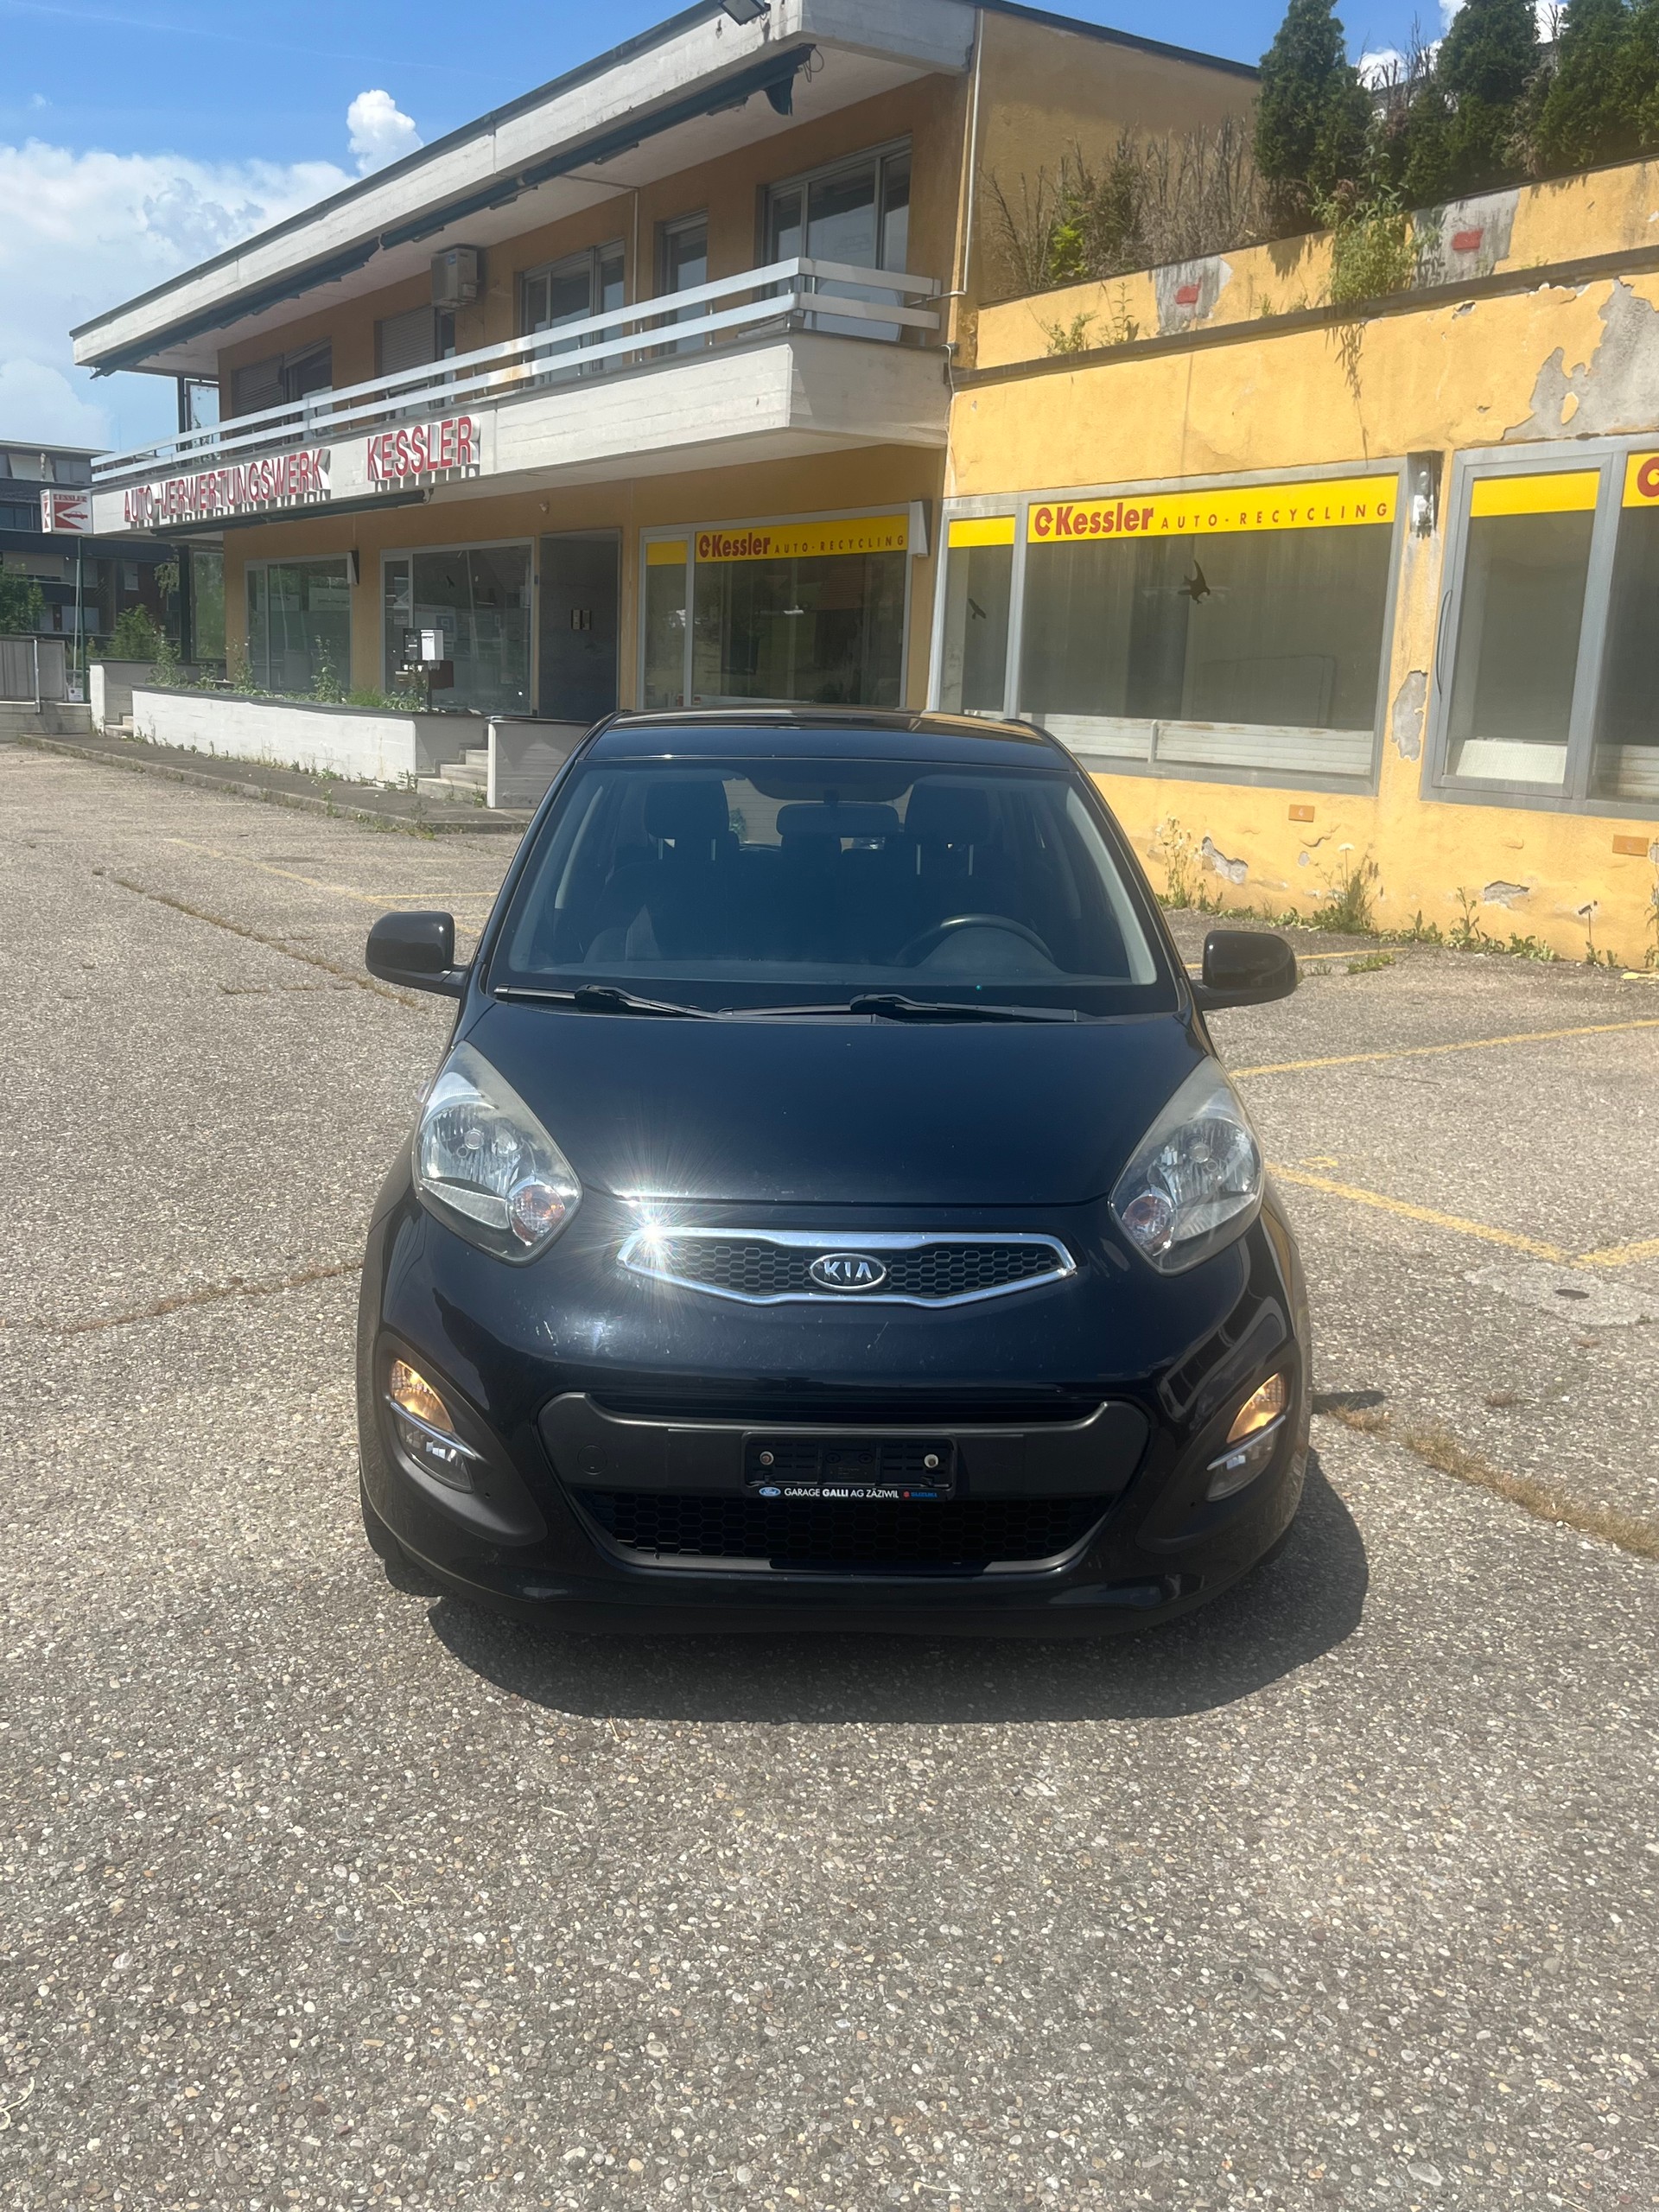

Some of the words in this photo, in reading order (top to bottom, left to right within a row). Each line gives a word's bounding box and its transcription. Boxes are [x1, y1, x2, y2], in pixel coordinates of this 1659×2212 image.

[124, 448, 325, 522] AUTO-VERWERTUNGSWERK
[367, 416, 473, 481] KESSLER
[1161, 502, 1388, 531] AUTO-RECYCLING
[774, 535, 904, 554] AUTO-RECYCLING
[823, 1261, 874, 1282] KIA
[784, 1487, 821, 1497] GARAGE
[822, 1488, 849, 1497] GALLI
[850, 1489, 864, 1497] AG
